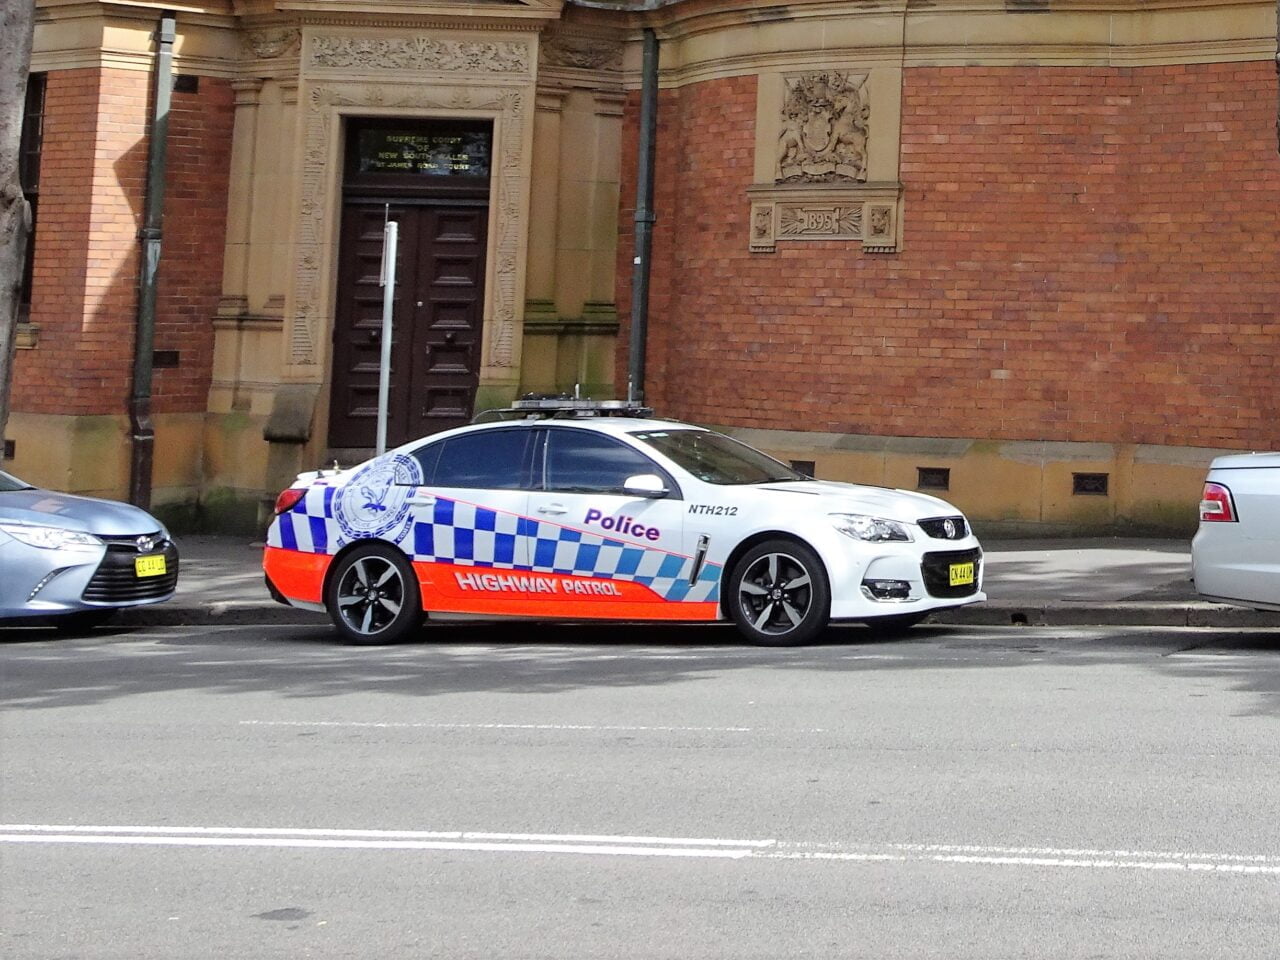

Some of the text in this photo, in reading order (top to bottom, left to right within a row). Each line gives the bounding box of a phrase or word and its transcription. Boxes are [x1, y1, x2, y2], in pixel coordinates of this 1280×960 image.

[385, 135, 462, 144] SUPREME COURT
[416, 144, 431, 152] OF
[403, 152, 432, 160] SOUTH
[803, 212, 832, 230] 1895
[688, 504, 738, 516] NTH212
[584, 508, 660, 541] Police
[454, 572, 622, 596] HIGHWAY PATROL
